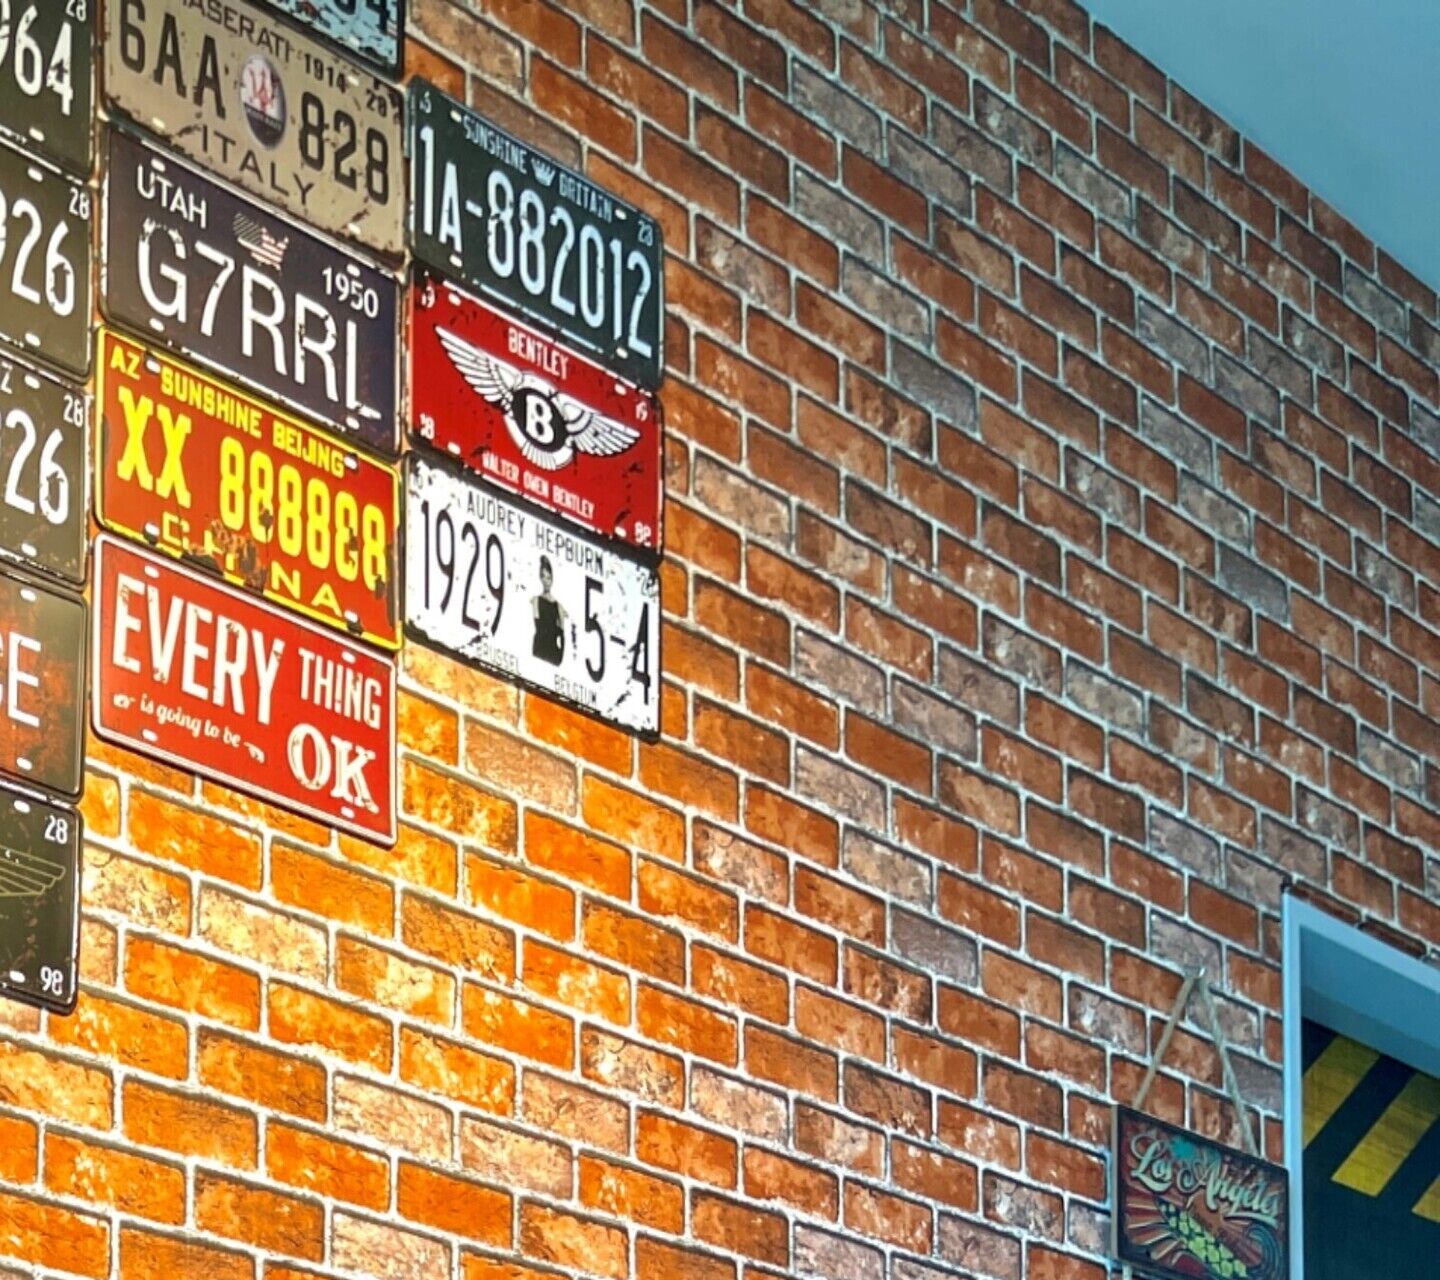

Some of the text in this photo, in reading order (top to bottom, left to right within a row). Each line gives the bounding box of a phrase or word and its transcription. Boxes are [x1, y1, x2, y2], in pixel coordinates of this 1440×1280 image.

[120, 0, 390, 206] 6AA 828
[304, 52, 349, 93] 1914
[199, 123, 316, 216] ITALY
[462, 114, 528, 175] SUNSHINE
[137, 163, 207, 229] UTAH
[321, 266, 379, 318] 1950
[110, 344, 141, 380] AZ
[507, 326, 570, 381] BENTLEY
[116, 385, 192, 509] XX
[160, 369, 345, 479] SUNSHINE BEIJING
[526, 393, 556, 445] B
[481, 451, 520, 485] WALTER
[552, 484, 596, 520] BENTLEY
[465, 489, 605, 578] AUDREY HEPBURN
[420, 498, 505, 637] 1929
[111, 572, 285, 726] EVERY
[140, 692, 241, 748] is going to be
[286, 722, 380, 814] OK
[44, 815, 69, 844] 28
